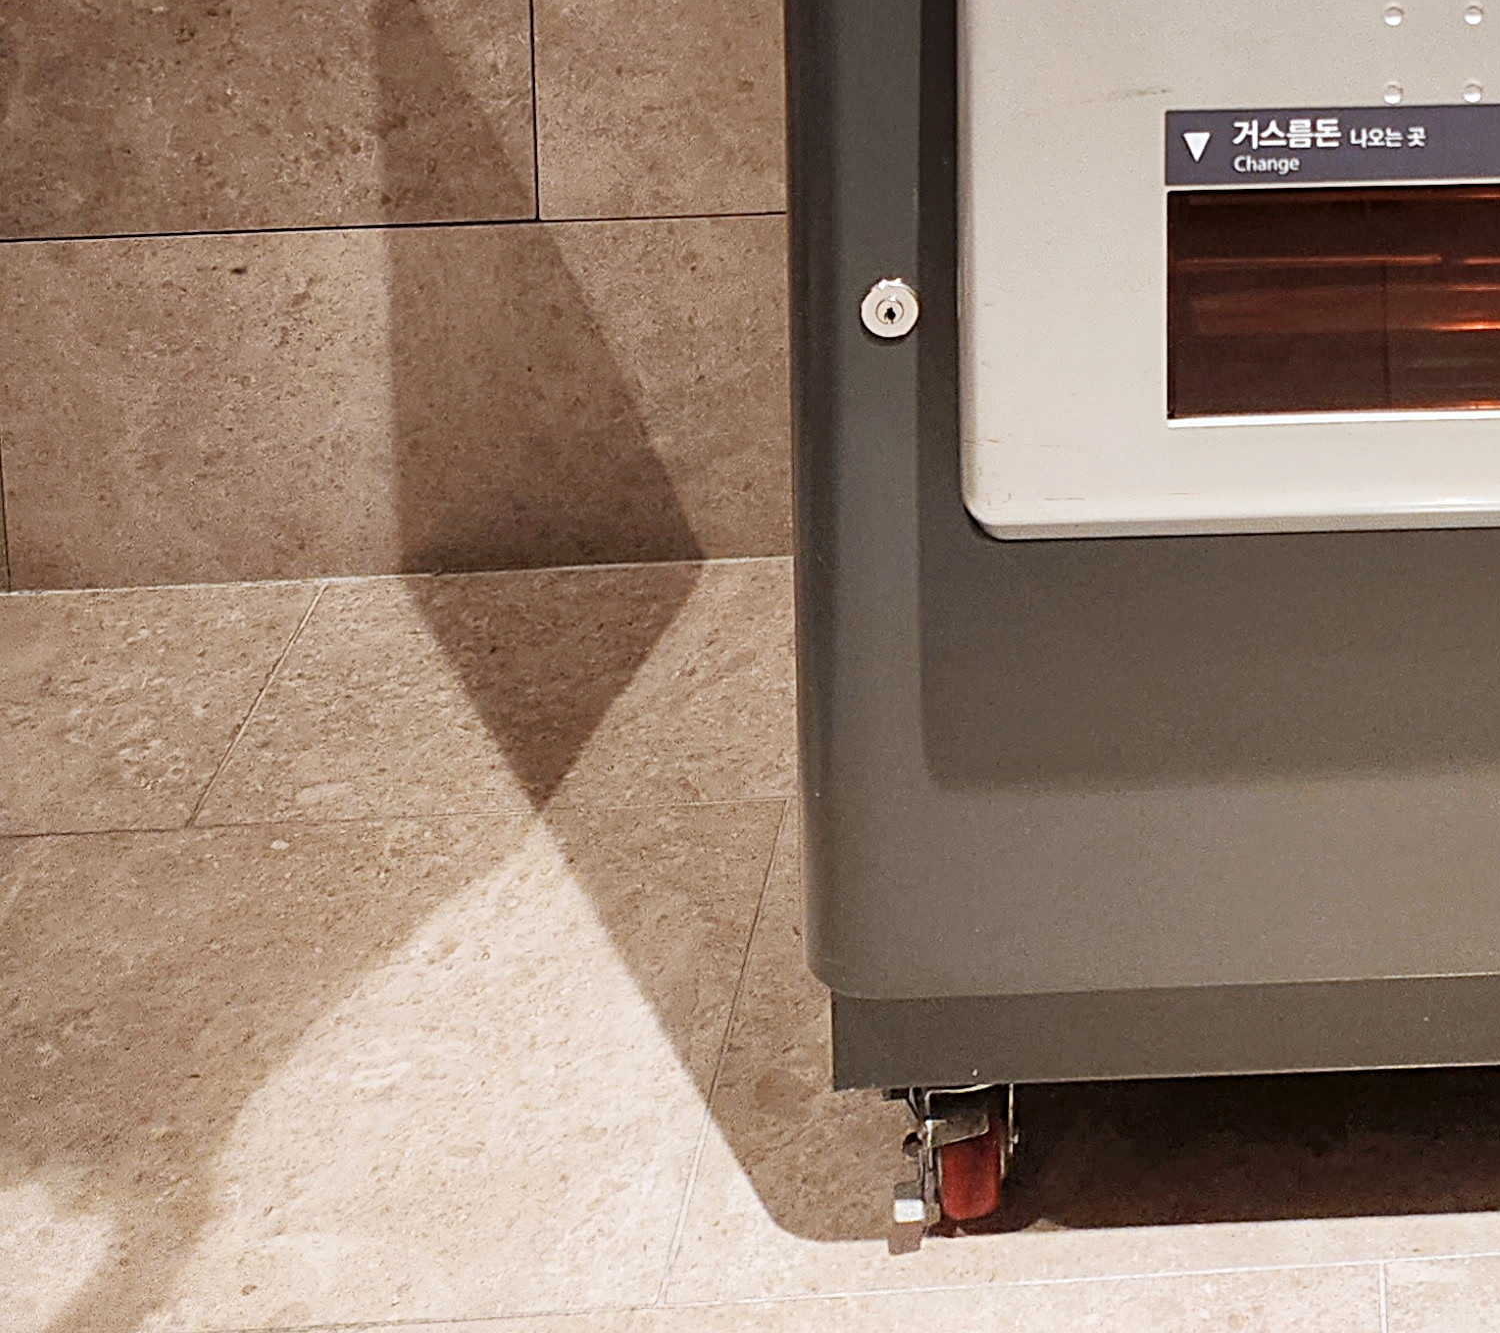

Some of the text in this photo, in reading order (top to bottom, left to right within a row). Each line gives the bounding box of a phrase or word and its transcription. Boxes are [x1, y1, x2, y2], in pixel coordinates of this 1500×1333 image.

[1232, 119, 1426, 149] 거스름돈 나오는 곳
[1234, 156, 1300, 175] Change
